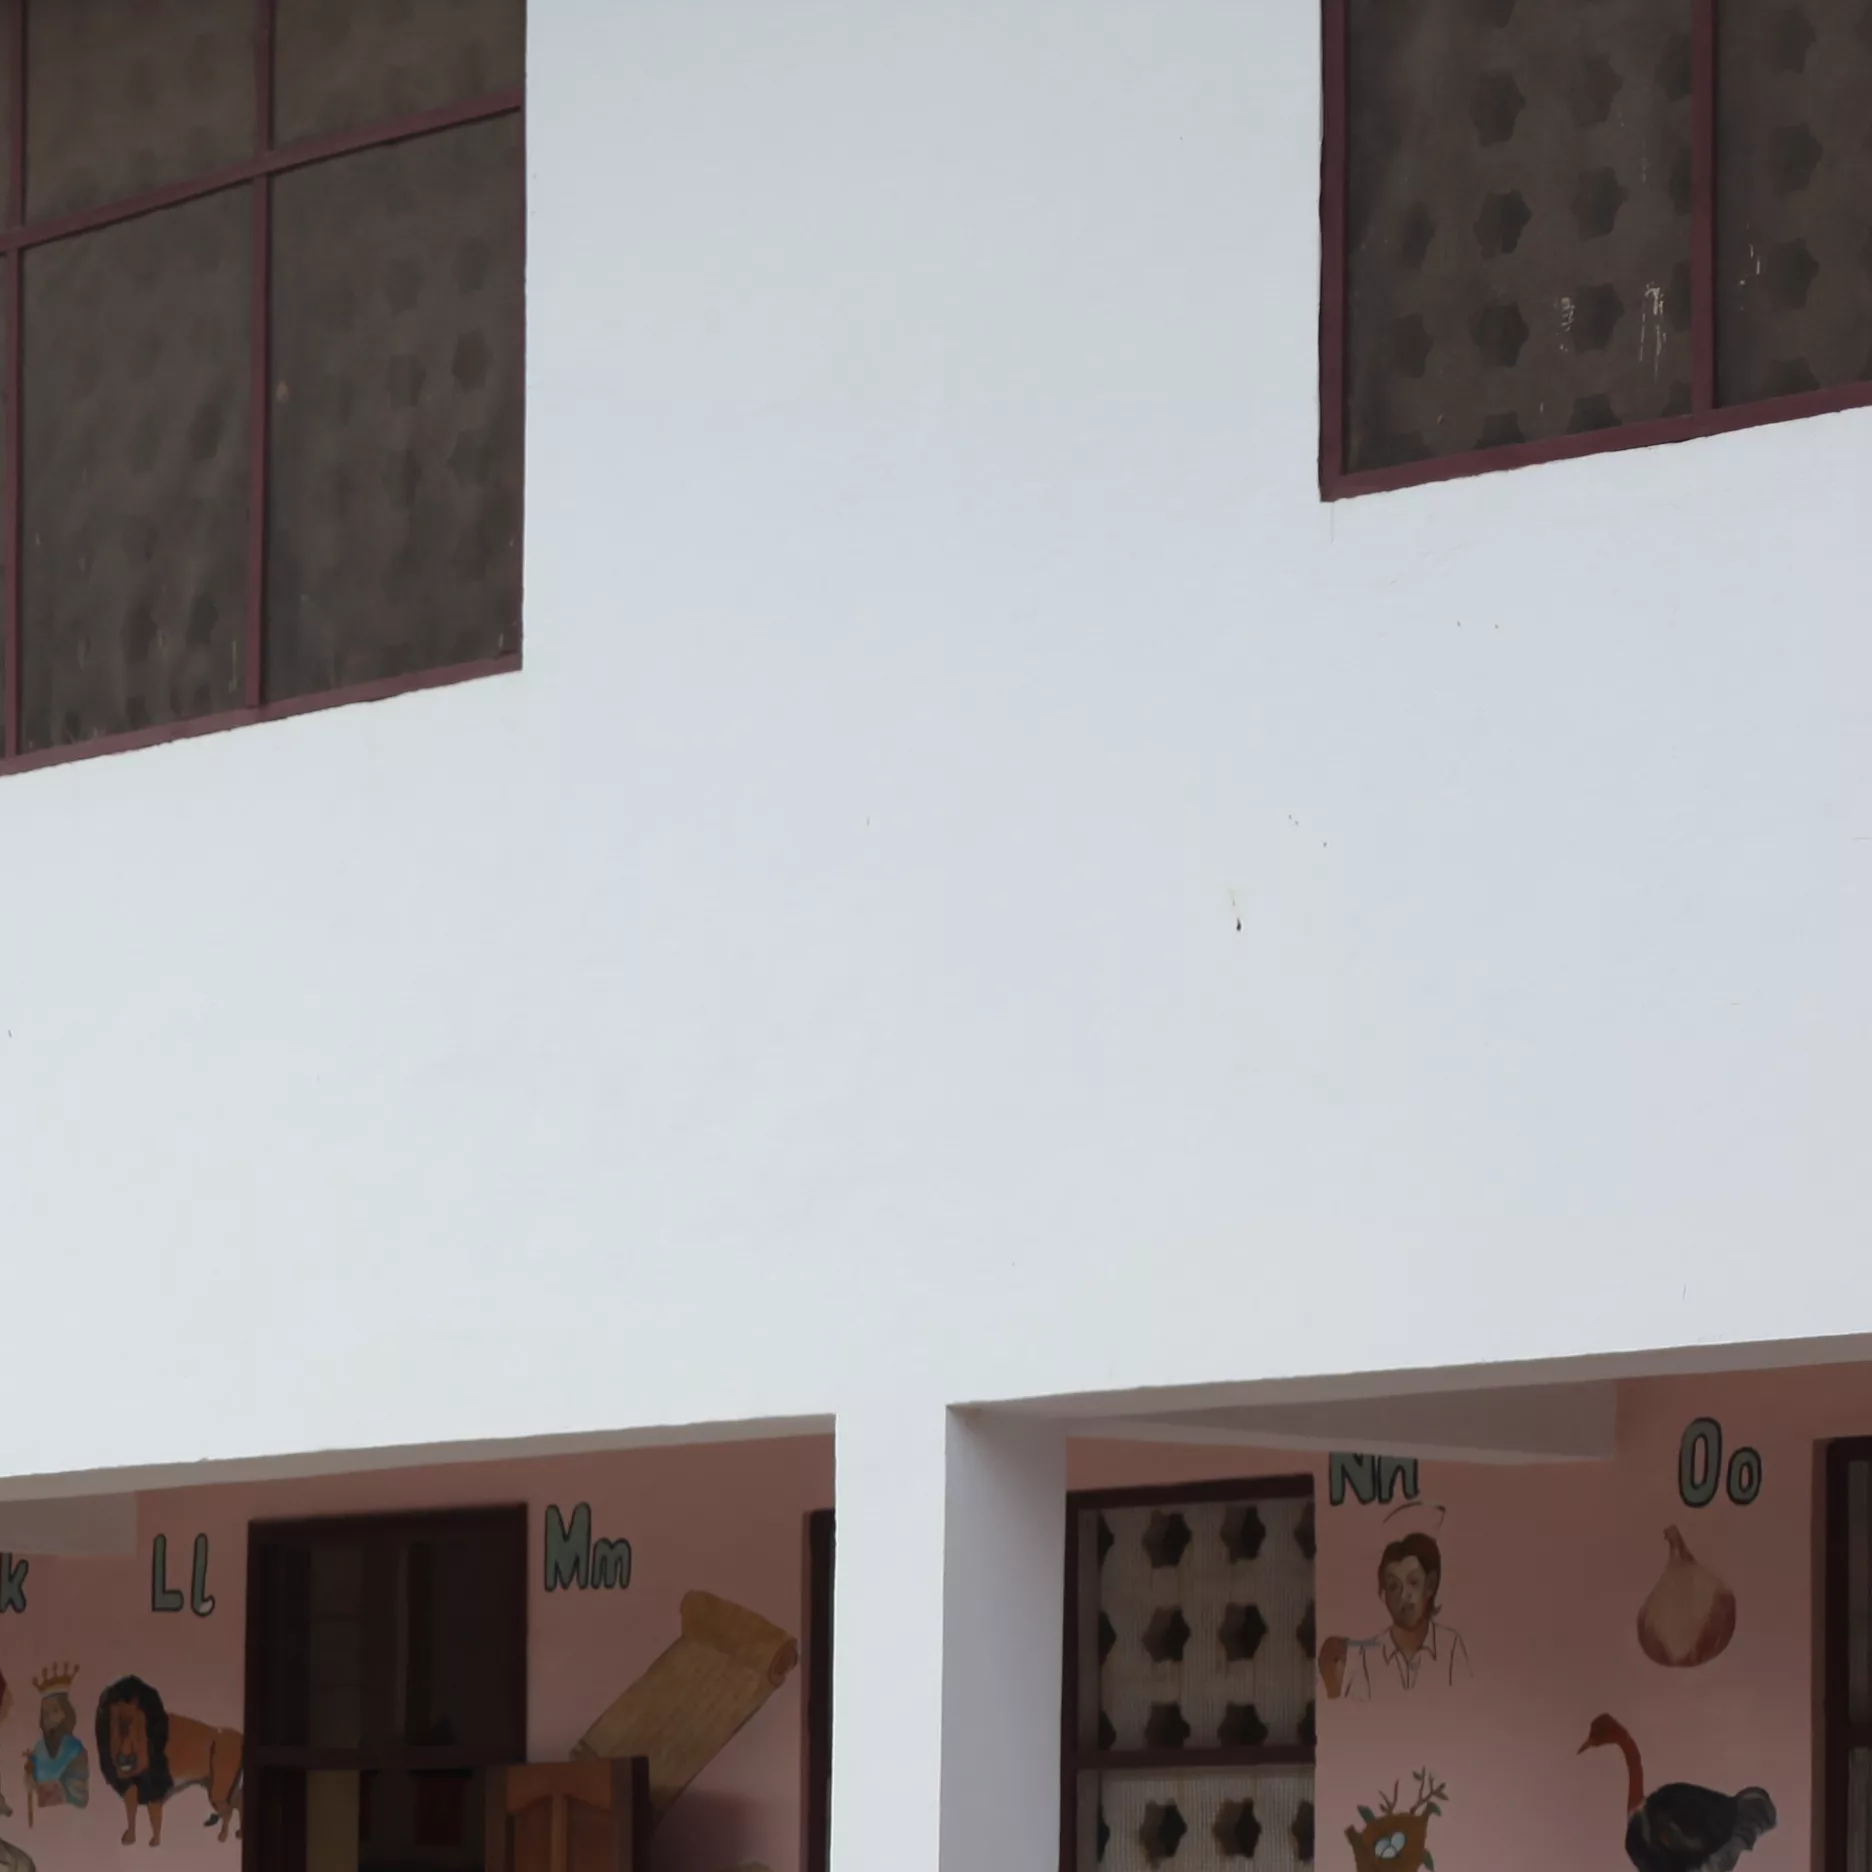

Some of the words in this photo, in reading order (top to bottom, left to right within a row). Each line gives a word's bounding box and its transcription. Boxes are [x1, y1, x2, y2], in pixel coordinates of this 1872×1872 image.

[1677, 1416, 1762, 1508] Oo
[151, 1533, 215, 1617] Ll
[543, 1502, 632, 1593] Mm
